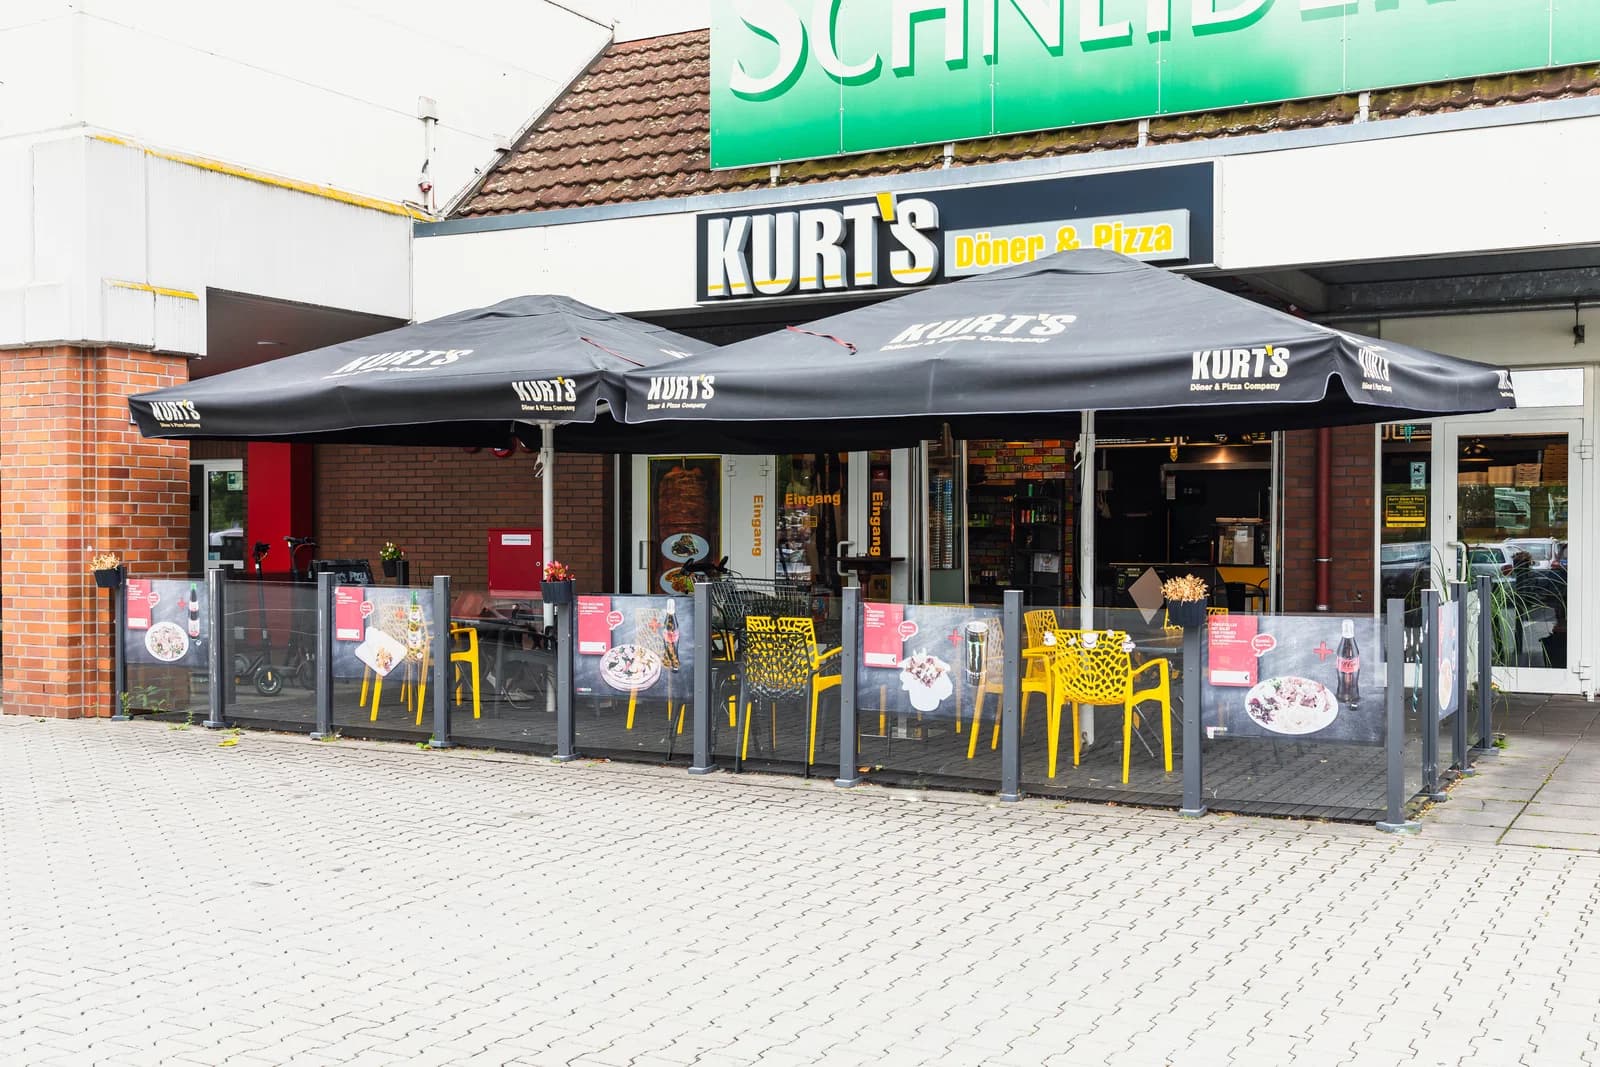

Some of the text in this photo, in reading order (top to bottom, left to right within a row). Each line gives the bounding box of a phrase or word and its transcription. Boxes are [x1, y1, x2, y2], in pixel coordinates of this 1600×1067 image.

[707, 192, 939, 297] KURT'S
[954, 232, 1045, 269] Döner
[1092, 220, 1173, 255] Pizza
[1191, 344, 1290, 380] KURT'S
[511, 375, 577, 402] KURT'S
[1190, 384, 1213, 392] Döner
[1222, 382, 1242, 391] Pizza
[1243, 382, 1281, 392] Company
[785, 493, 841, 506] Eingang
[751, 494, 764, 557] Eingang
[870, 491, 883, 556] Eingang
